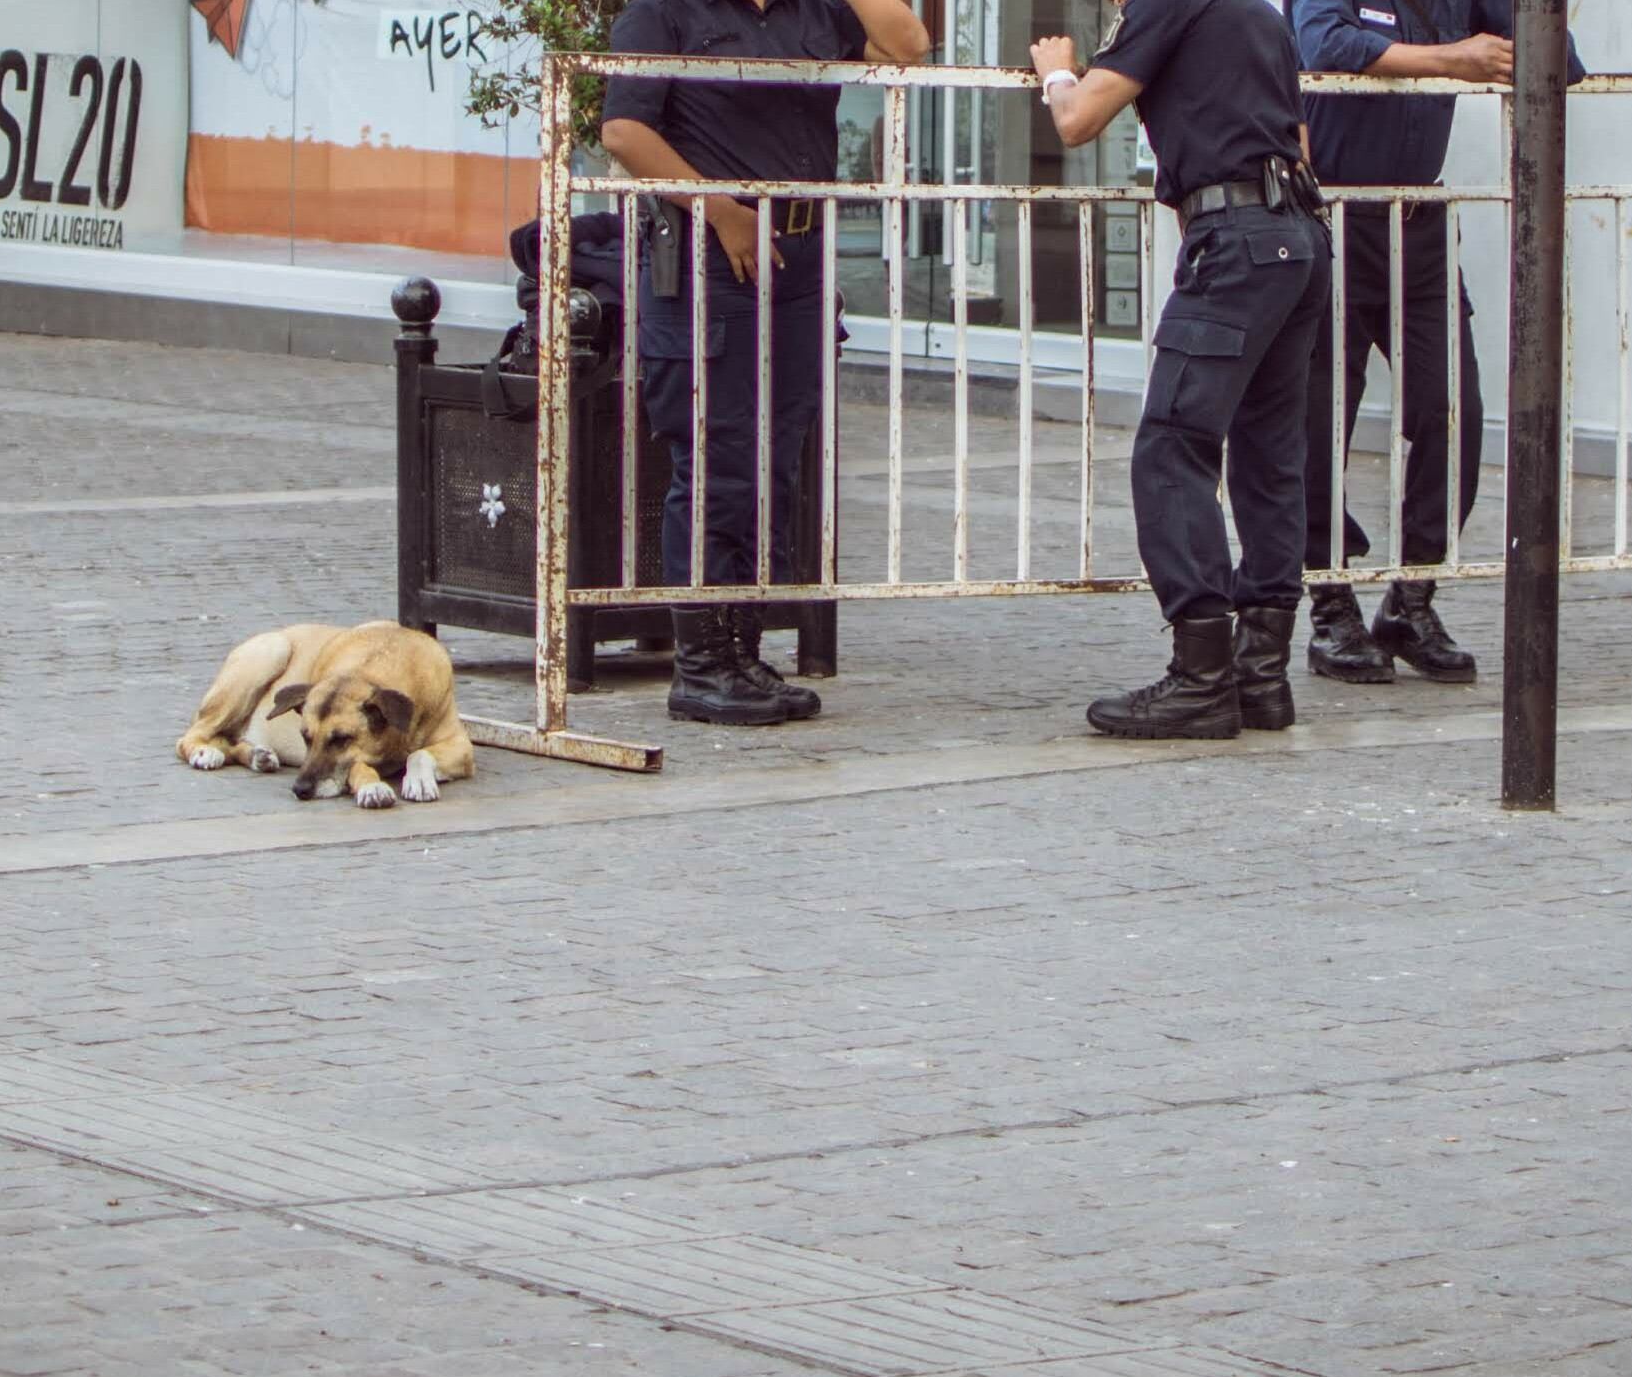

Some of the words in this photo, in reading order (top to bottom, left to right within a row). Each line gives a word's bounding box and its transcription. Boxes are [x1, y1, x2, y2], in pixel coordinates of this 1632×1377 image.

[390, 10, 487, 92] AYER
[0, 206, 39, 239] SENTÍ
[42, 213, 59, 242] LA
[61, 215, 124, 250] LIGEREZA
